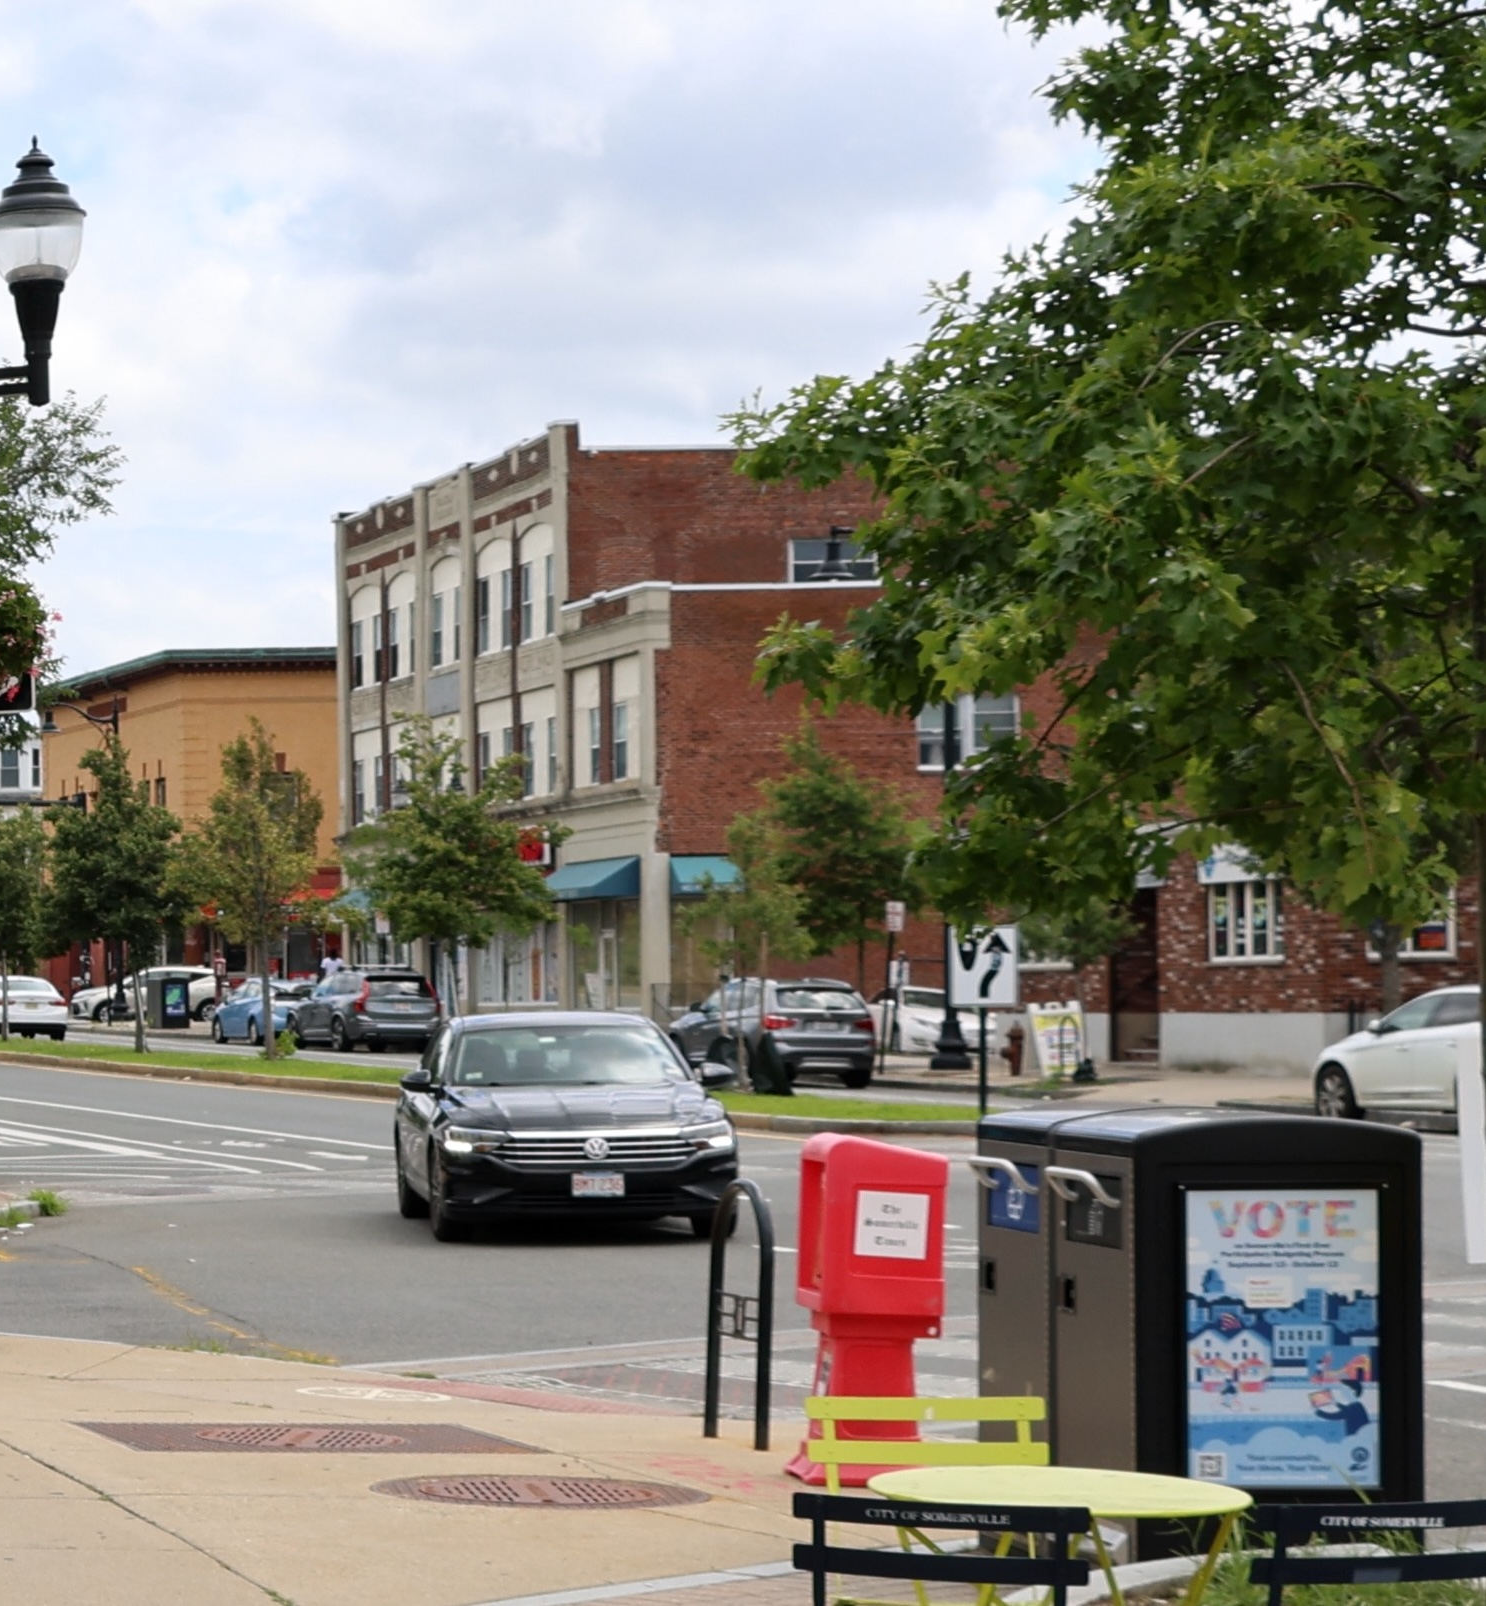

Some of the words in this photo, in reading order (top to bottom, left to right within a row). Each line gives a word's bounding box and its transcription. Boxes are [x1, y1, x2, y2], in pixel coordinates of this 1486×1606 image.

[881, 1203, 902, 1215] The
[863, 1217, 919, 1231] Somerville
[1209, 1199, 1357, 1239] VOTE
[874, 1235, 907, 1247] Times
[864, 1507, 898, 1519] CITY
[900, 1510, 919, 1521] OF
[920, 1511, 1011, 1526] SOMERVILLE
[1319, 1515, 1350, 1527] CITY
[1350, 1516, 1369, 1528] OF
[1369, 1516, 1445, 1528] SOMERVILLE
